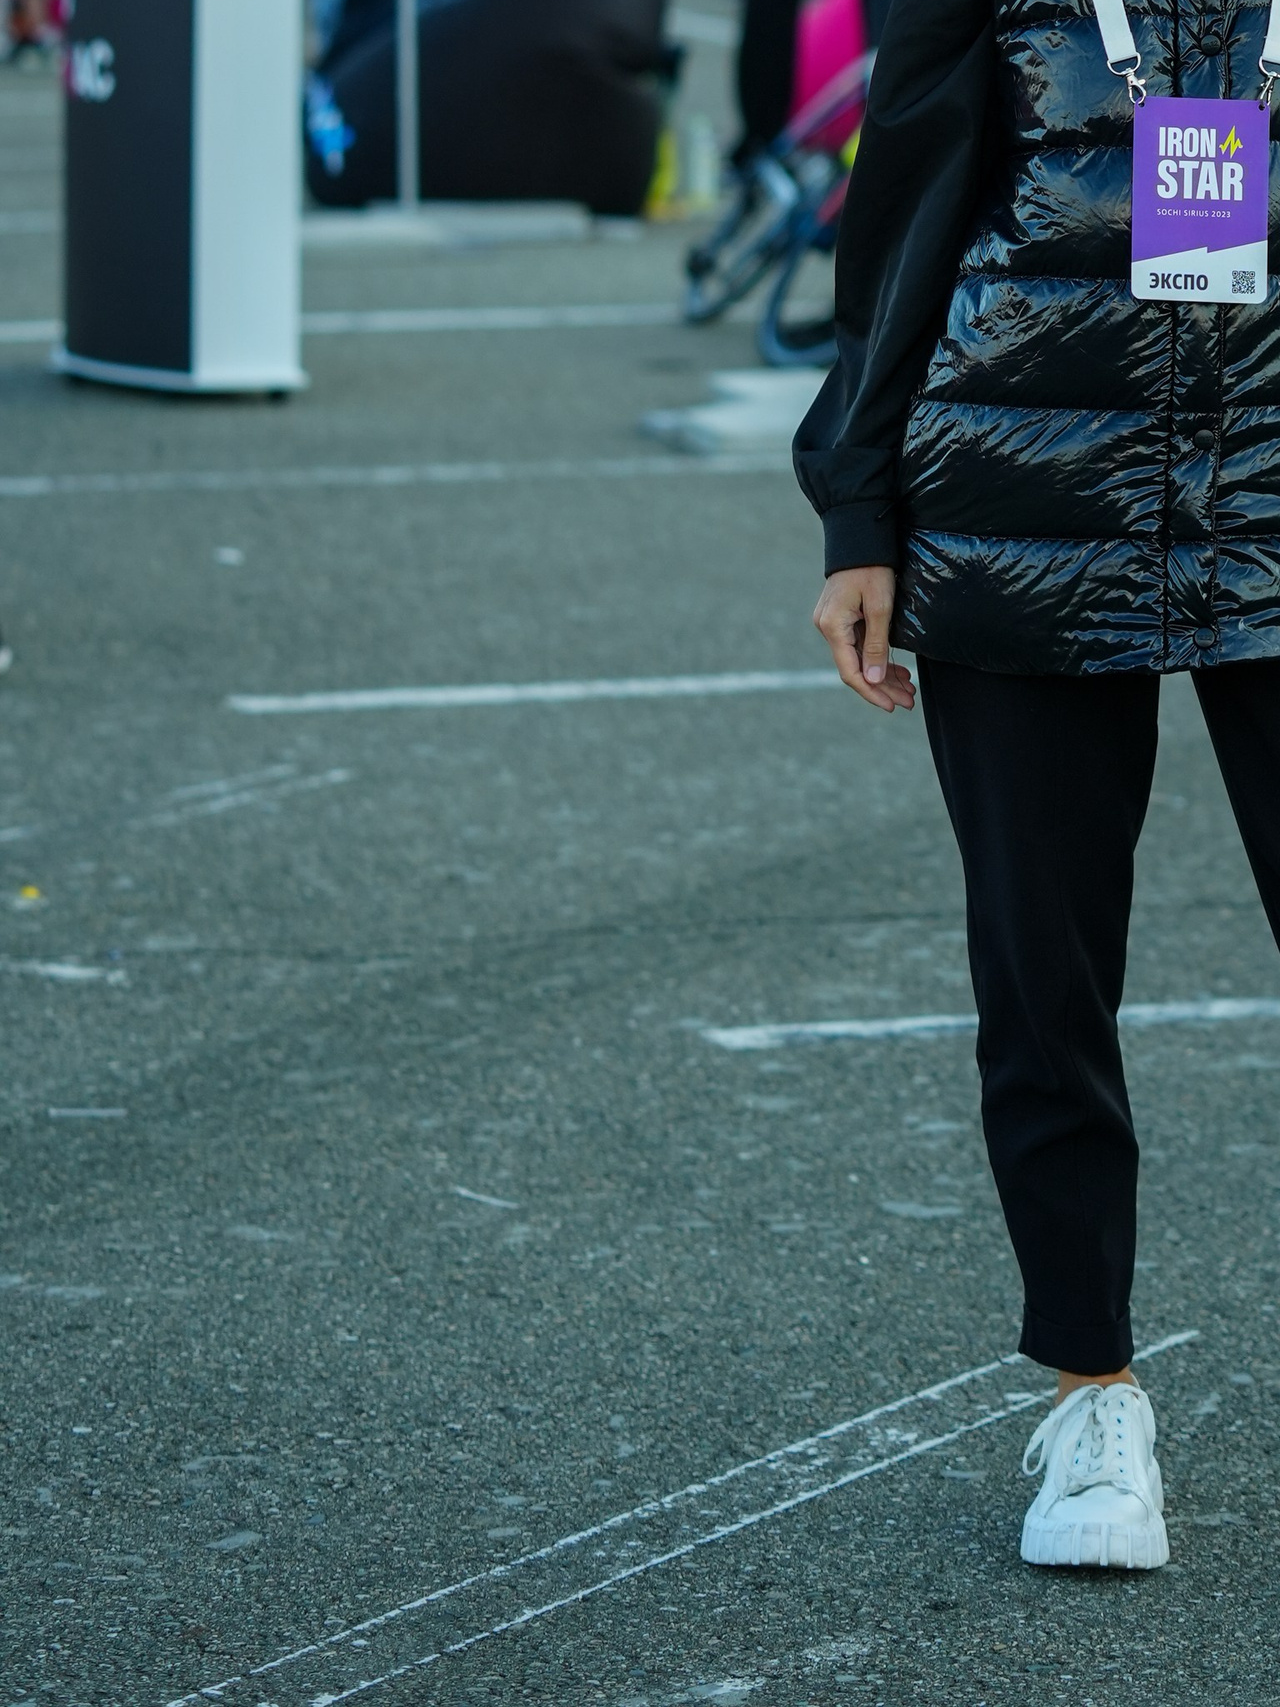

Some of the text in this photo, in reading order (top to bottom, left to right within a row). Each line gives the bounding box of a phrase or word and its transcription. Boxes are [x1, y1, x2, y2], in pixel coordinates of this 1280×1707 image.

[1158, 126, 1217, 158] IRON
[1156, 159, 1244, 201] STAR
[1156, 208, 1231, 218] SOCHI SIRIUS 2023
[1149, 272, 1209, 291] ЭКСПО
